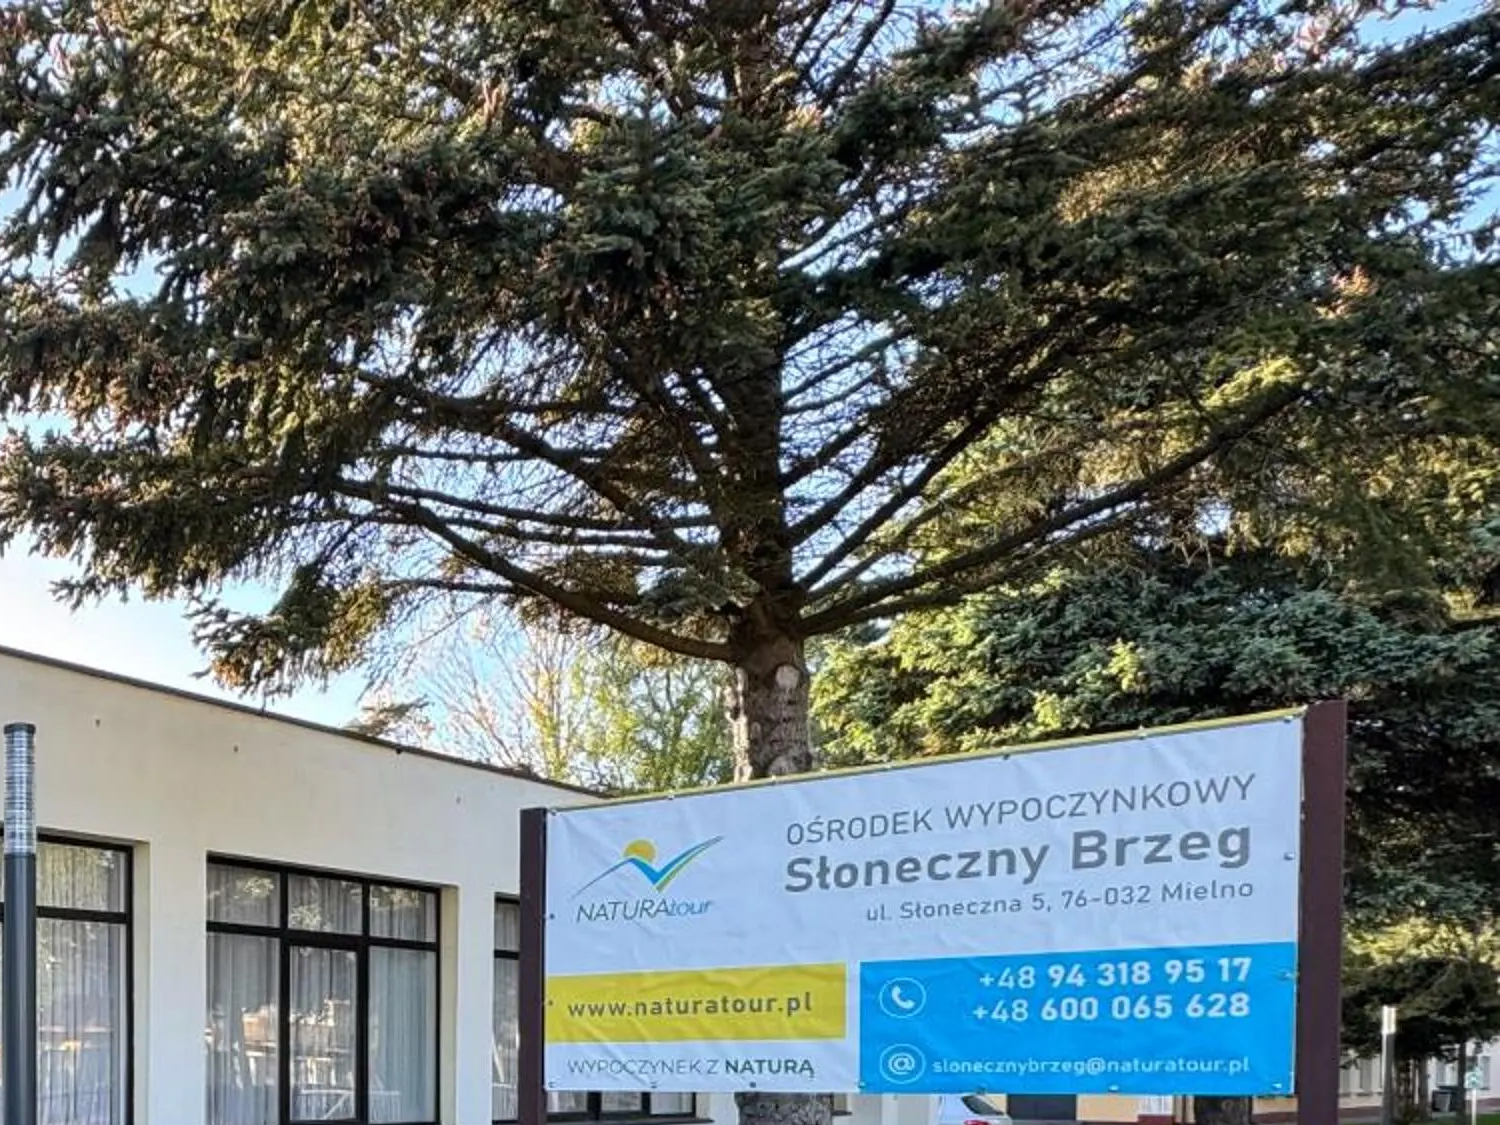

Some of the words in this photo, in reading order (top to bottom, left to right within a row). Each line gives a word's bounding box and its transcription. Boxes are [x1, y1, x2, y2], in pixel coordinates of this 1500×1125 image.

[786, 809, 933, 846] OŚRODEK
[945, 773, 1256, 830] WYPOCZYNKOWY
[785, 844, 1050, 892] Słoneczny
[1071, 826, 1252, 870] Brzeg
[575, 898, 713, 924] NATURAtour
[866, 905, 892, 922] ul.
[899, 896, 1022, 920] Słoneczna
[1031, 894, 1052, 913] 5,
[1061, 884, 1151, 909] 76-032
[1161, 880, 1254, 901] Mielno
[980, 965, 1036, 989] +48
[1048, 964, 1086, 987] 94
[1097, 962, 1150, 986] 318
[1164, 958, 1206, 983] 95
[1217, 957, 1253, 982] 17
[568, 992, 813, 1018] www.naturatour.pl
[973, 1000, 1030, 1022] +48
[1040, 998, 1100, 1021] 600
[1111, 995, 1173, 1020] 065
[1185, 992, 1251, 1017] 628
[568, 1059, 701, 1076] WYPOCZYNEK
[707, 1059, 719, 1075] Z
[725, 1058, 816, 1079] NATURĄ
